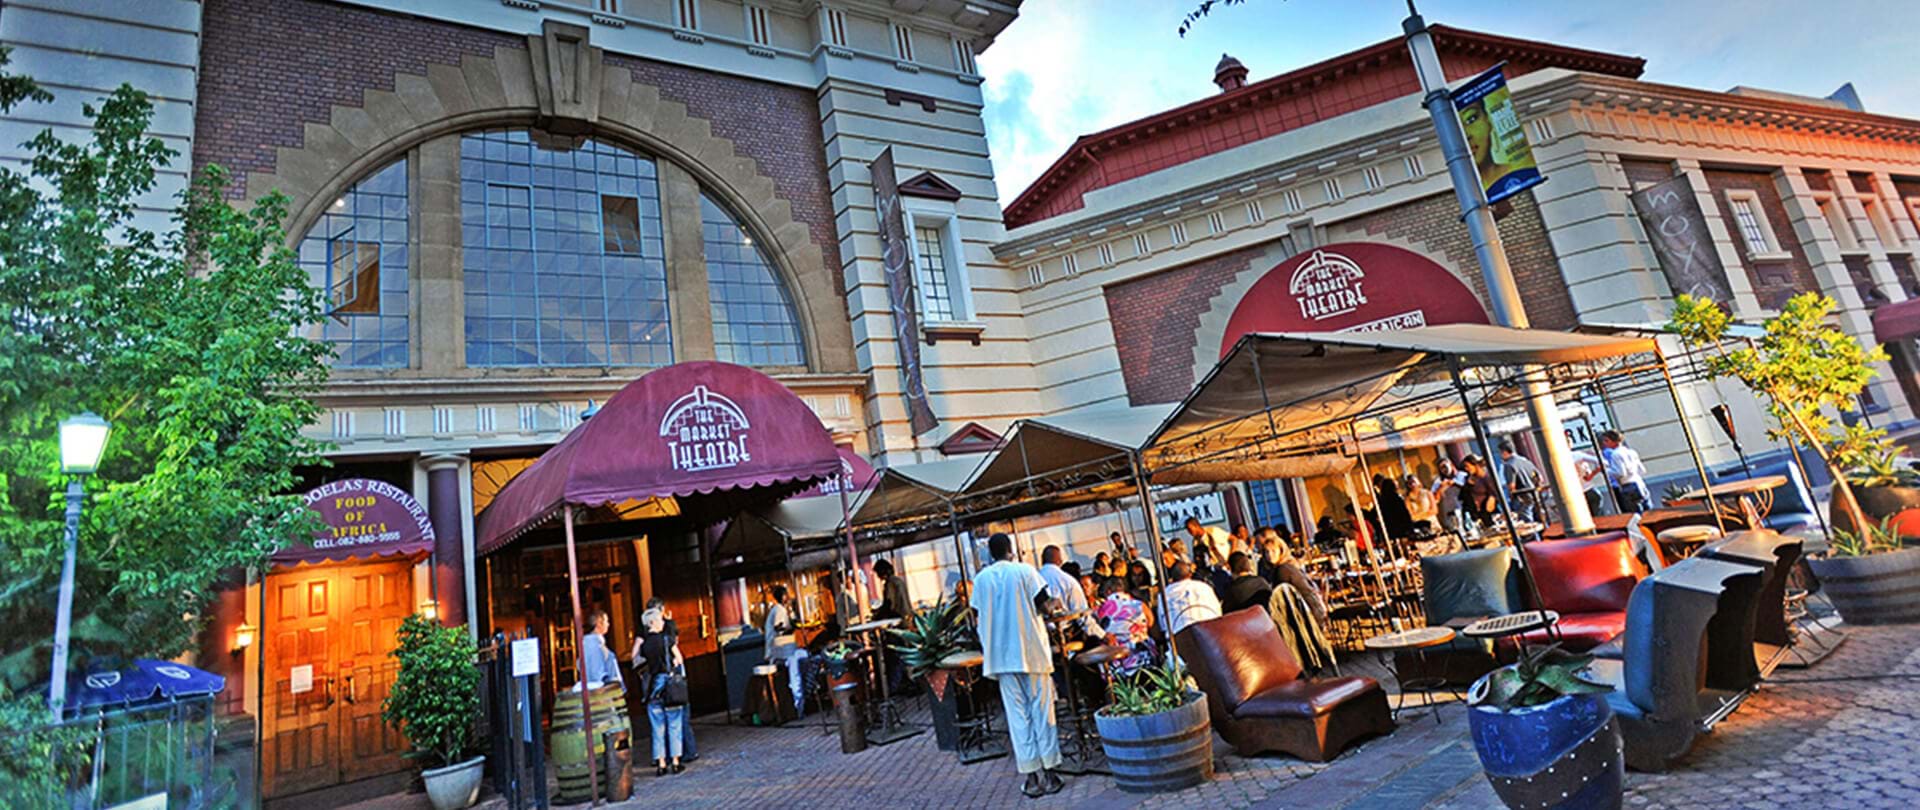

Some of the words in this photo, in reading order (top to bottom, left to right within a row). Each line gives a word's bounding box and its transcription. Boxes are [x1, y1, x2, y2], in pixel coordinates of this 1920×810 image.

[1315, 266, 1333, 279] THE
[1306, 277, 1348, 297] MARKET
[1296, 282, 1368, 318] THEATRE
[694, 408, 714, 422] THE
[679, 424, 730, 443] MARKET
[668, 434, 750, 470] THEATRE
[335, 496, 376, 509] FOOD
[366, 480, 435, 540] RESTAURANT
[345, 511, 364, 522] OF
[331, 523, 387, 538] AFRICA
